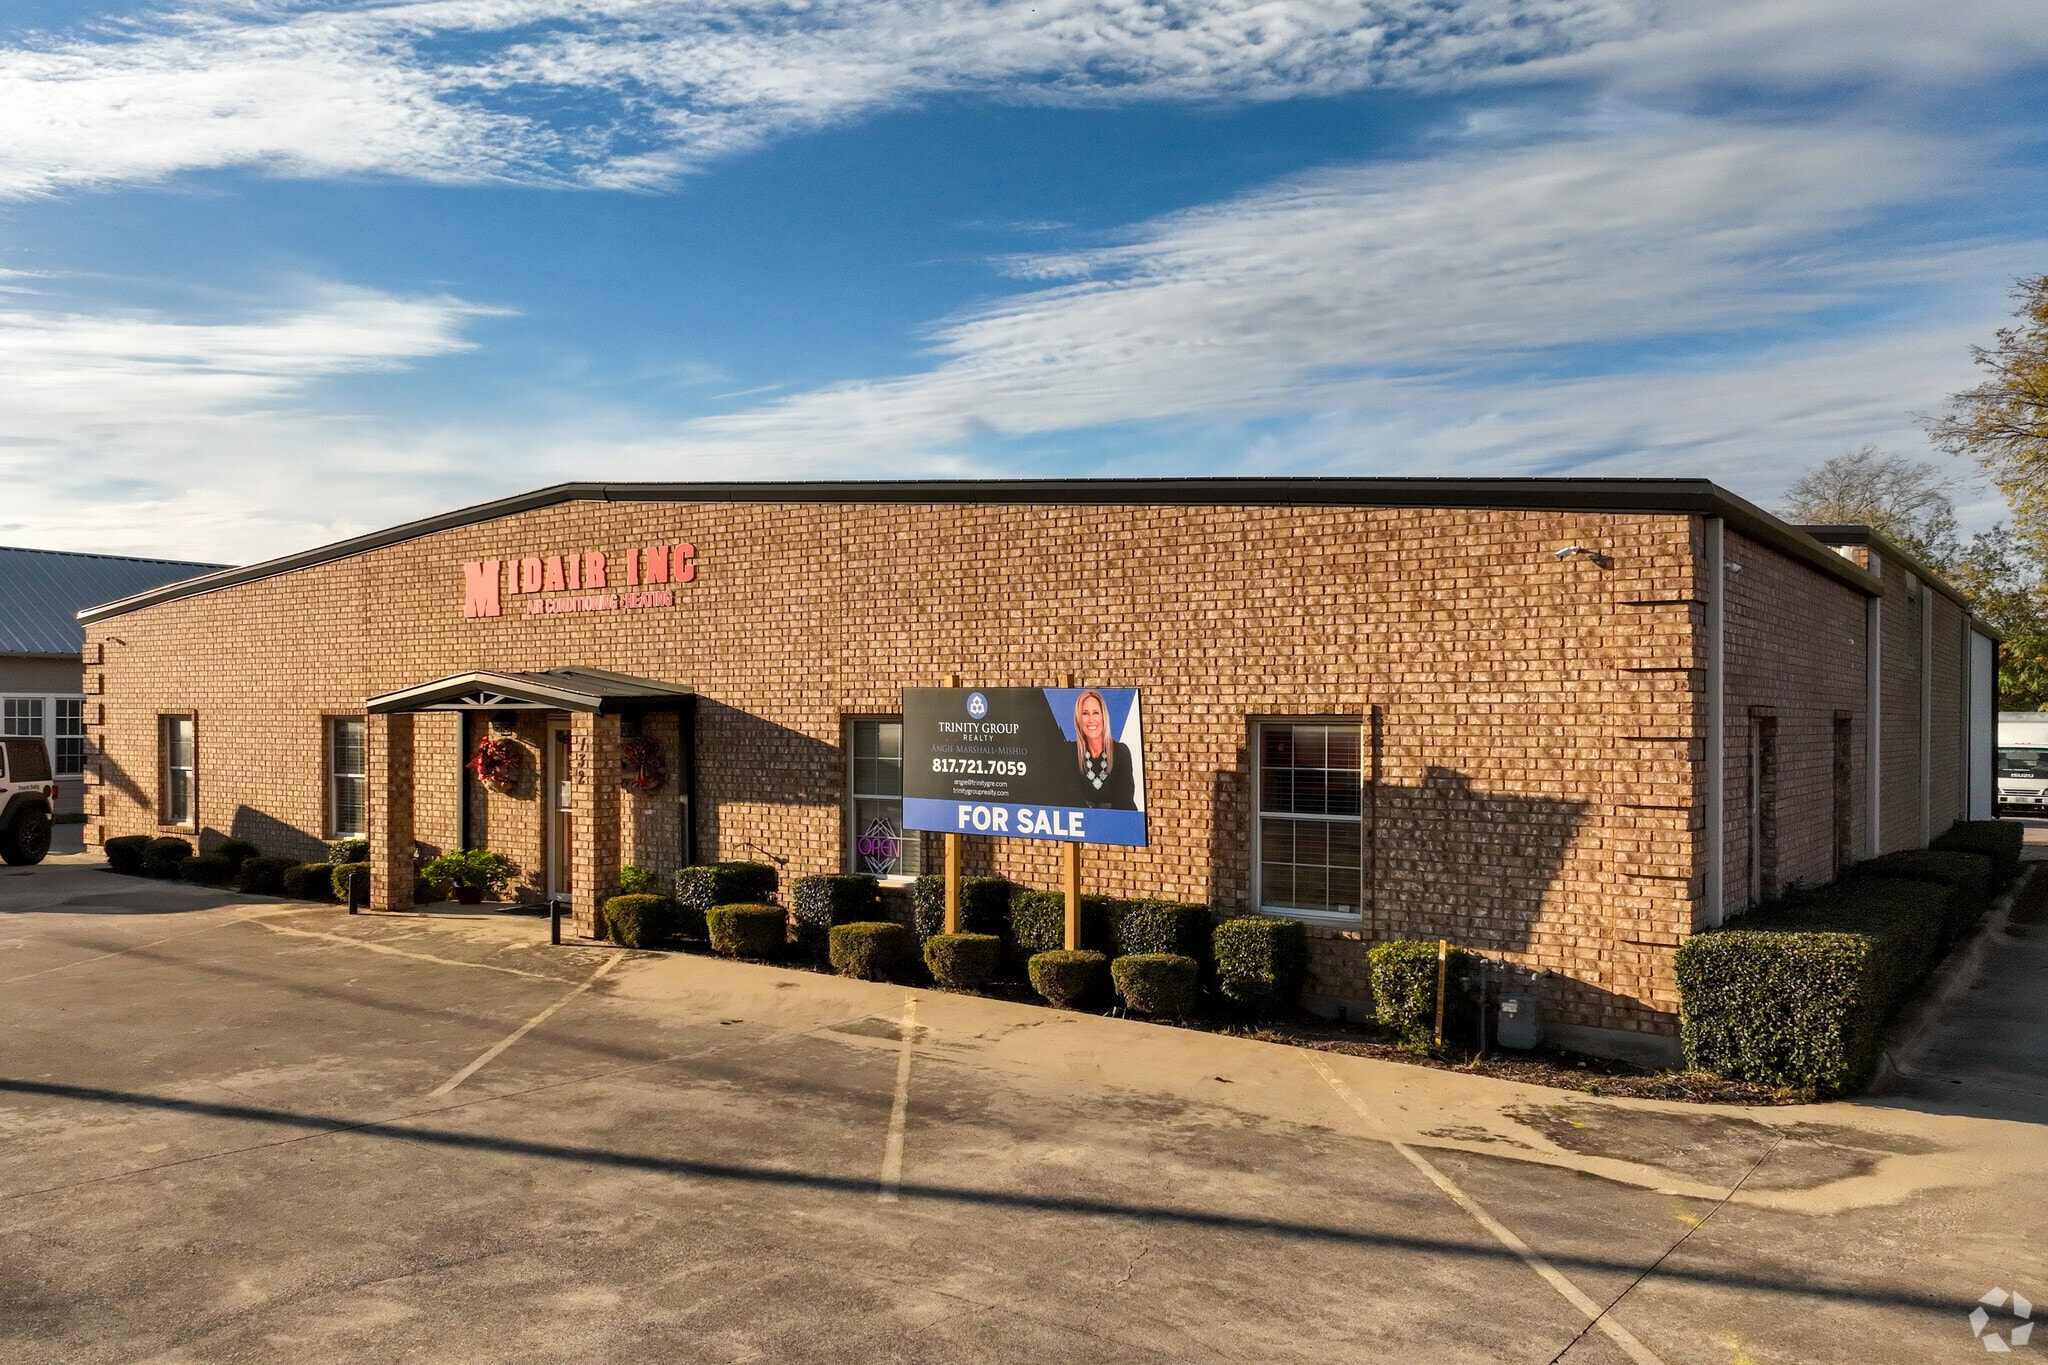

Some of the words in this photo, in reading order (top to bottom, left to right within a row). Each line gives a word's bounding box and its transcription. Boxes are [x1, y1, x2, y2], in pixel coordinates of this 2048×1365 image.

[464, 550, 607, 618] MIDAIR
[627, 543, 695, 586] INC
[527, 598, 545, 616] AIR
[545, 594, 618, 614] CONDITIONING
[625, 590, 673, 609] HEATING
[938, 721, 980, 733] TRINITY
[981, 722, 1020, 735] GROUP
[963, 733, 994, 742] REALTY
[931, 743, 954, 753] ANGIE
[577, 737, 586, 785] 132
[932, 758, 1027, 776] 817.721.7059
[953, 787, 1010, 797] trinitygrouprealty.com
[958, 804, 1009, 832] FOR
[1017, 809, 1086, 838] SALE
[858, 837, 900, 858] OPEN
